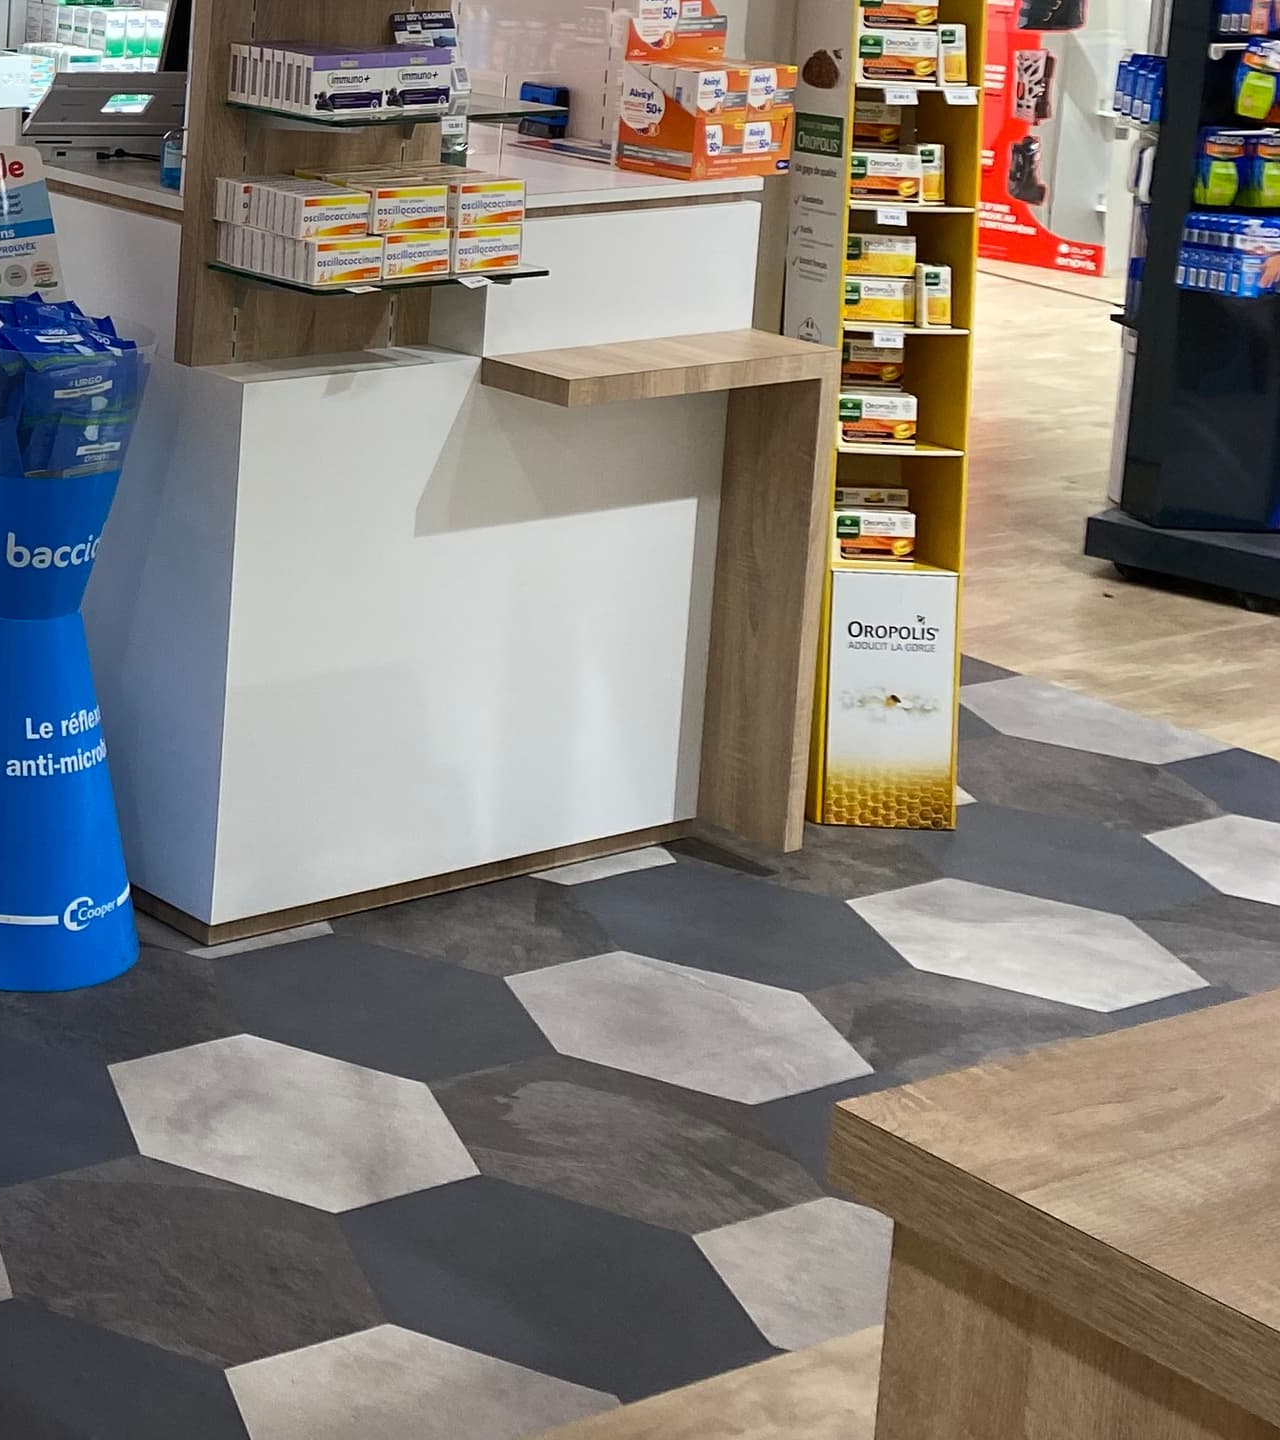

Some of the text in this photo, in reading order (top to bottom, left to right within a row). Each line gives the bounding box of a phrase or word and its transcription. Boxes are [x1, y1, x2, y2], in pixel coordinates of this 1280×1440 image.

[663, 8, 677, 20] 50+
[646, 103, 662, 114] 50+
[891, 642, 902, 652] LA
[905, 643, 936, 652] GORGE
[25, 717, 53, 740] Le
[78, 896, 117, 921] Cooper
